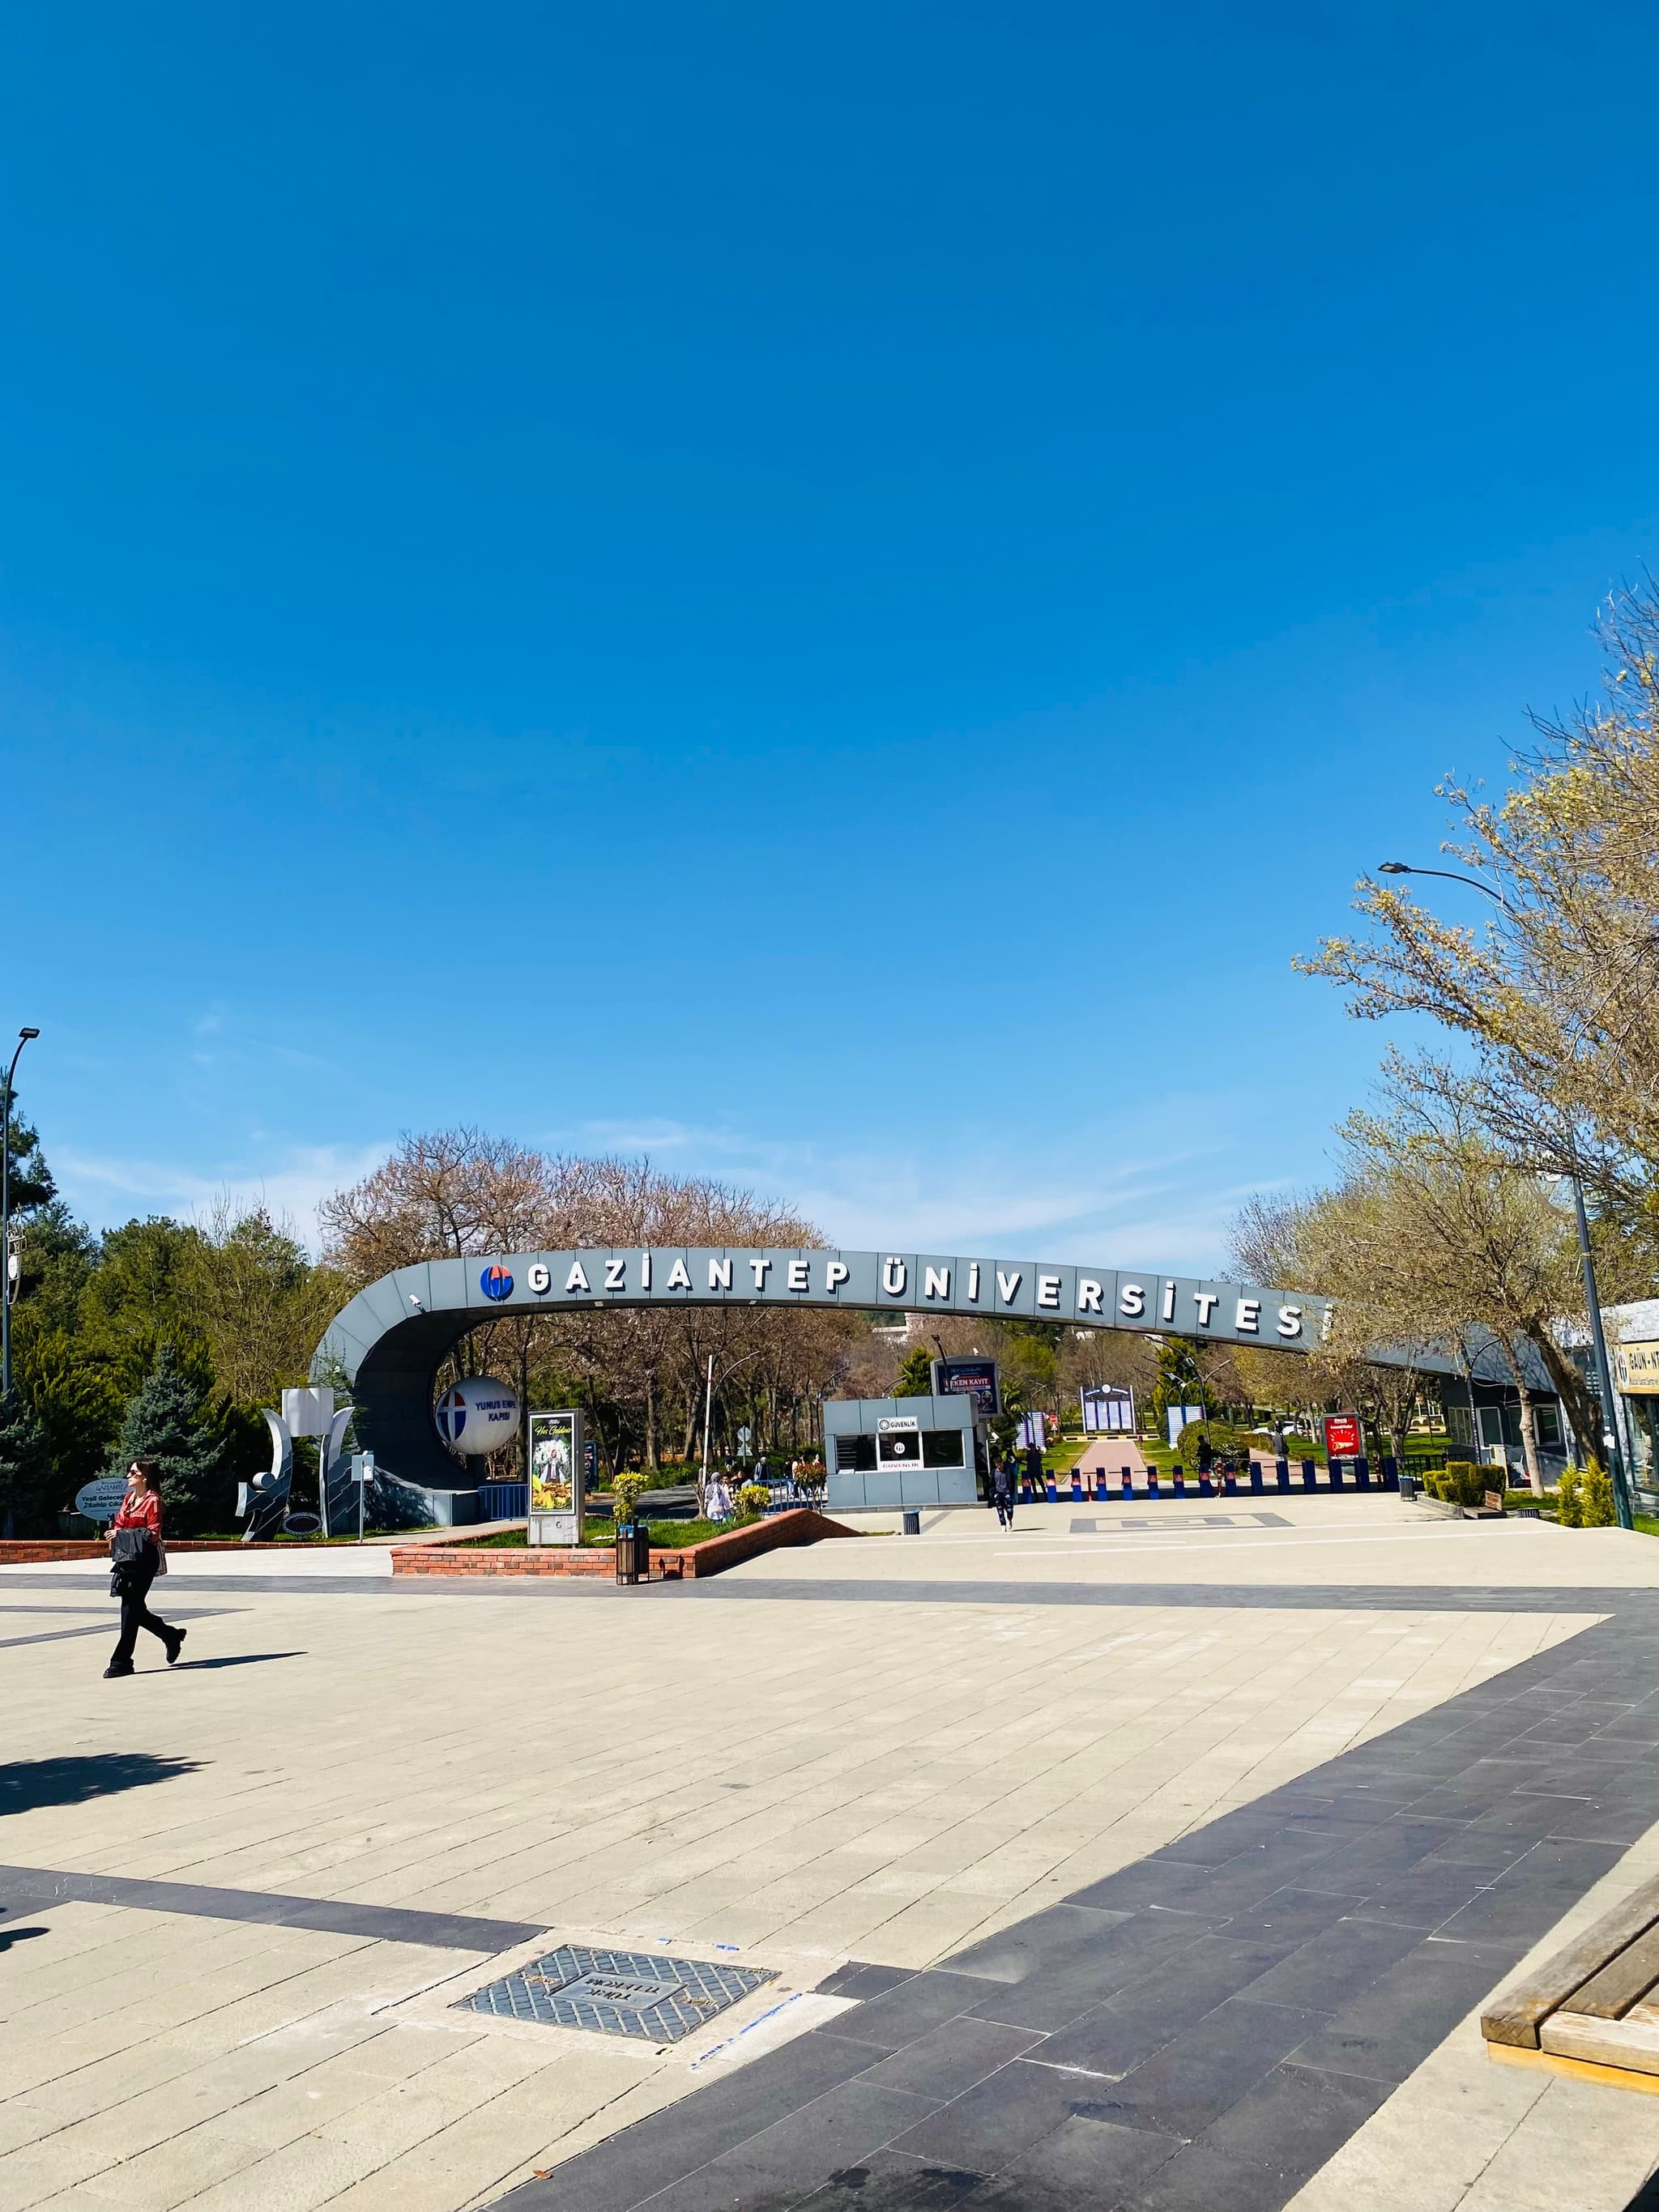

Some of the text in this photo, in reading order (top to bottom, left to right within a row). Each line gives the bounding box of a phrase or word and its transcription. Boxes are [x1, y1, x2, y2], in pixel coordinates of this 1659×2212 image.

[527, 1253, 1334, 1341] GAZİANTEP ÜNİVERSİTESİ
[475, 1400, 501, 1411] YUNUS
[488, 1412, 510, 1421] KAPISI
[890, 1420, 915, 1428] GÜVENLİK
